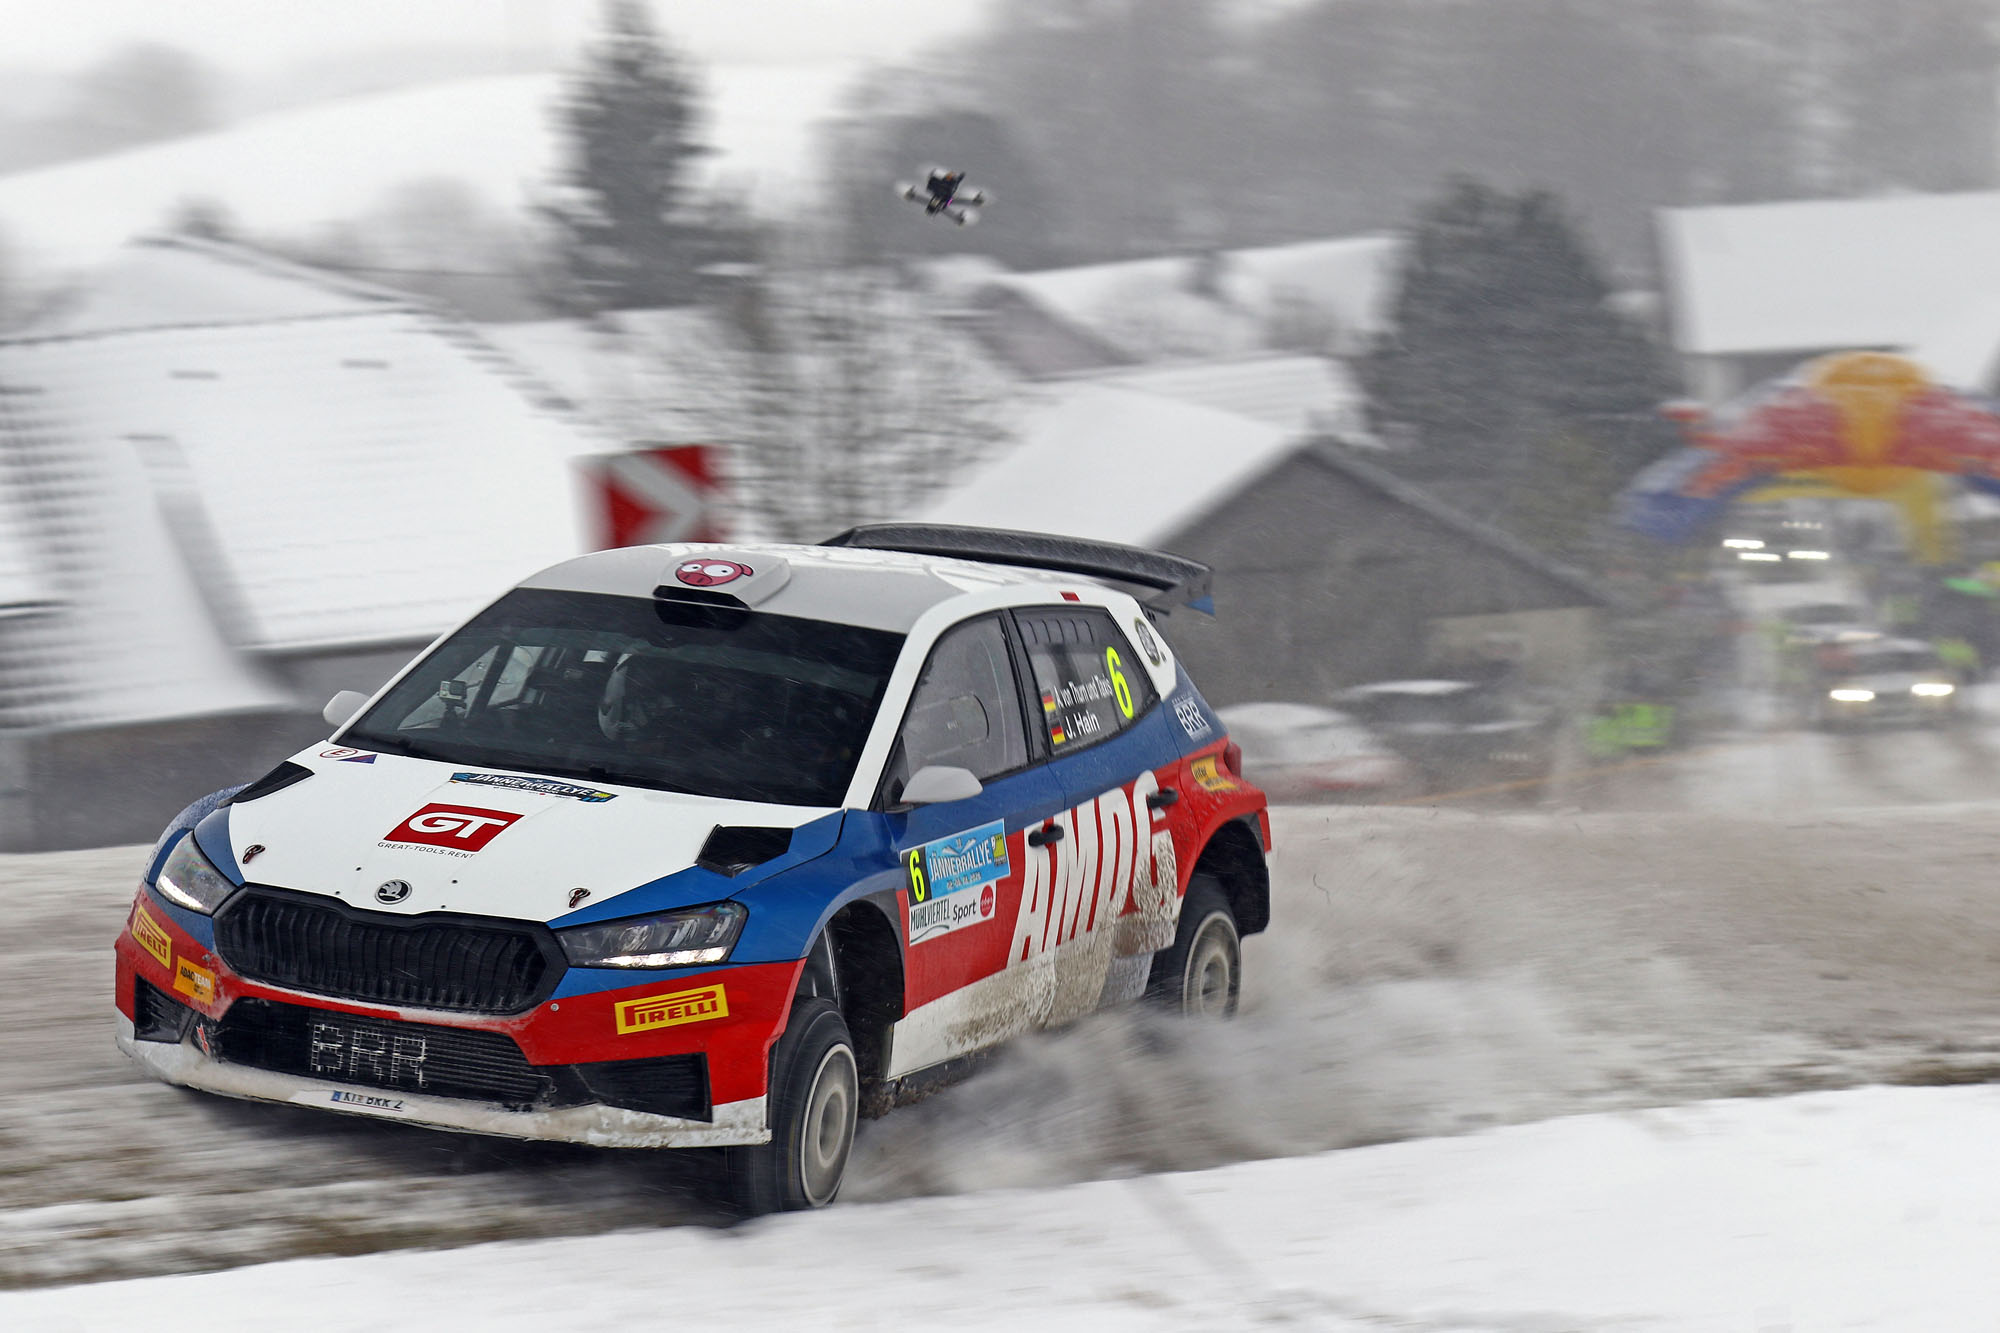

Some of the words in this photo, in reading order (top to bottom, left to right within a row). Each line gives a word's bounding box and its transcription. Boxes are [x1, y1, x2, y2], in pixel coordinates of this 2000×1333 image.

[1106, 646, 1134, 720] 6
[1065, 715, 1077, 740] J.
[1073, 709, 1101, 737] Hain
[1175, 700, 1210, 735] BRR
[408, 812, 509, 839] GT
[377, 841, 475, 859] GREAT-TOOLS.RENT
[929, 838, 992, 882] JÄNNERRALLYE
[909, 849, 925, 902] 6
[910, 898, 950, 932] MÜHLVIERTEL
[952, 899, 977, 925] Sport
[135, 911, 168, 960] PIRELLI
[624, 990, 718, 1027] PIRELLI
[310, 1023, 428, 1088] BRR
